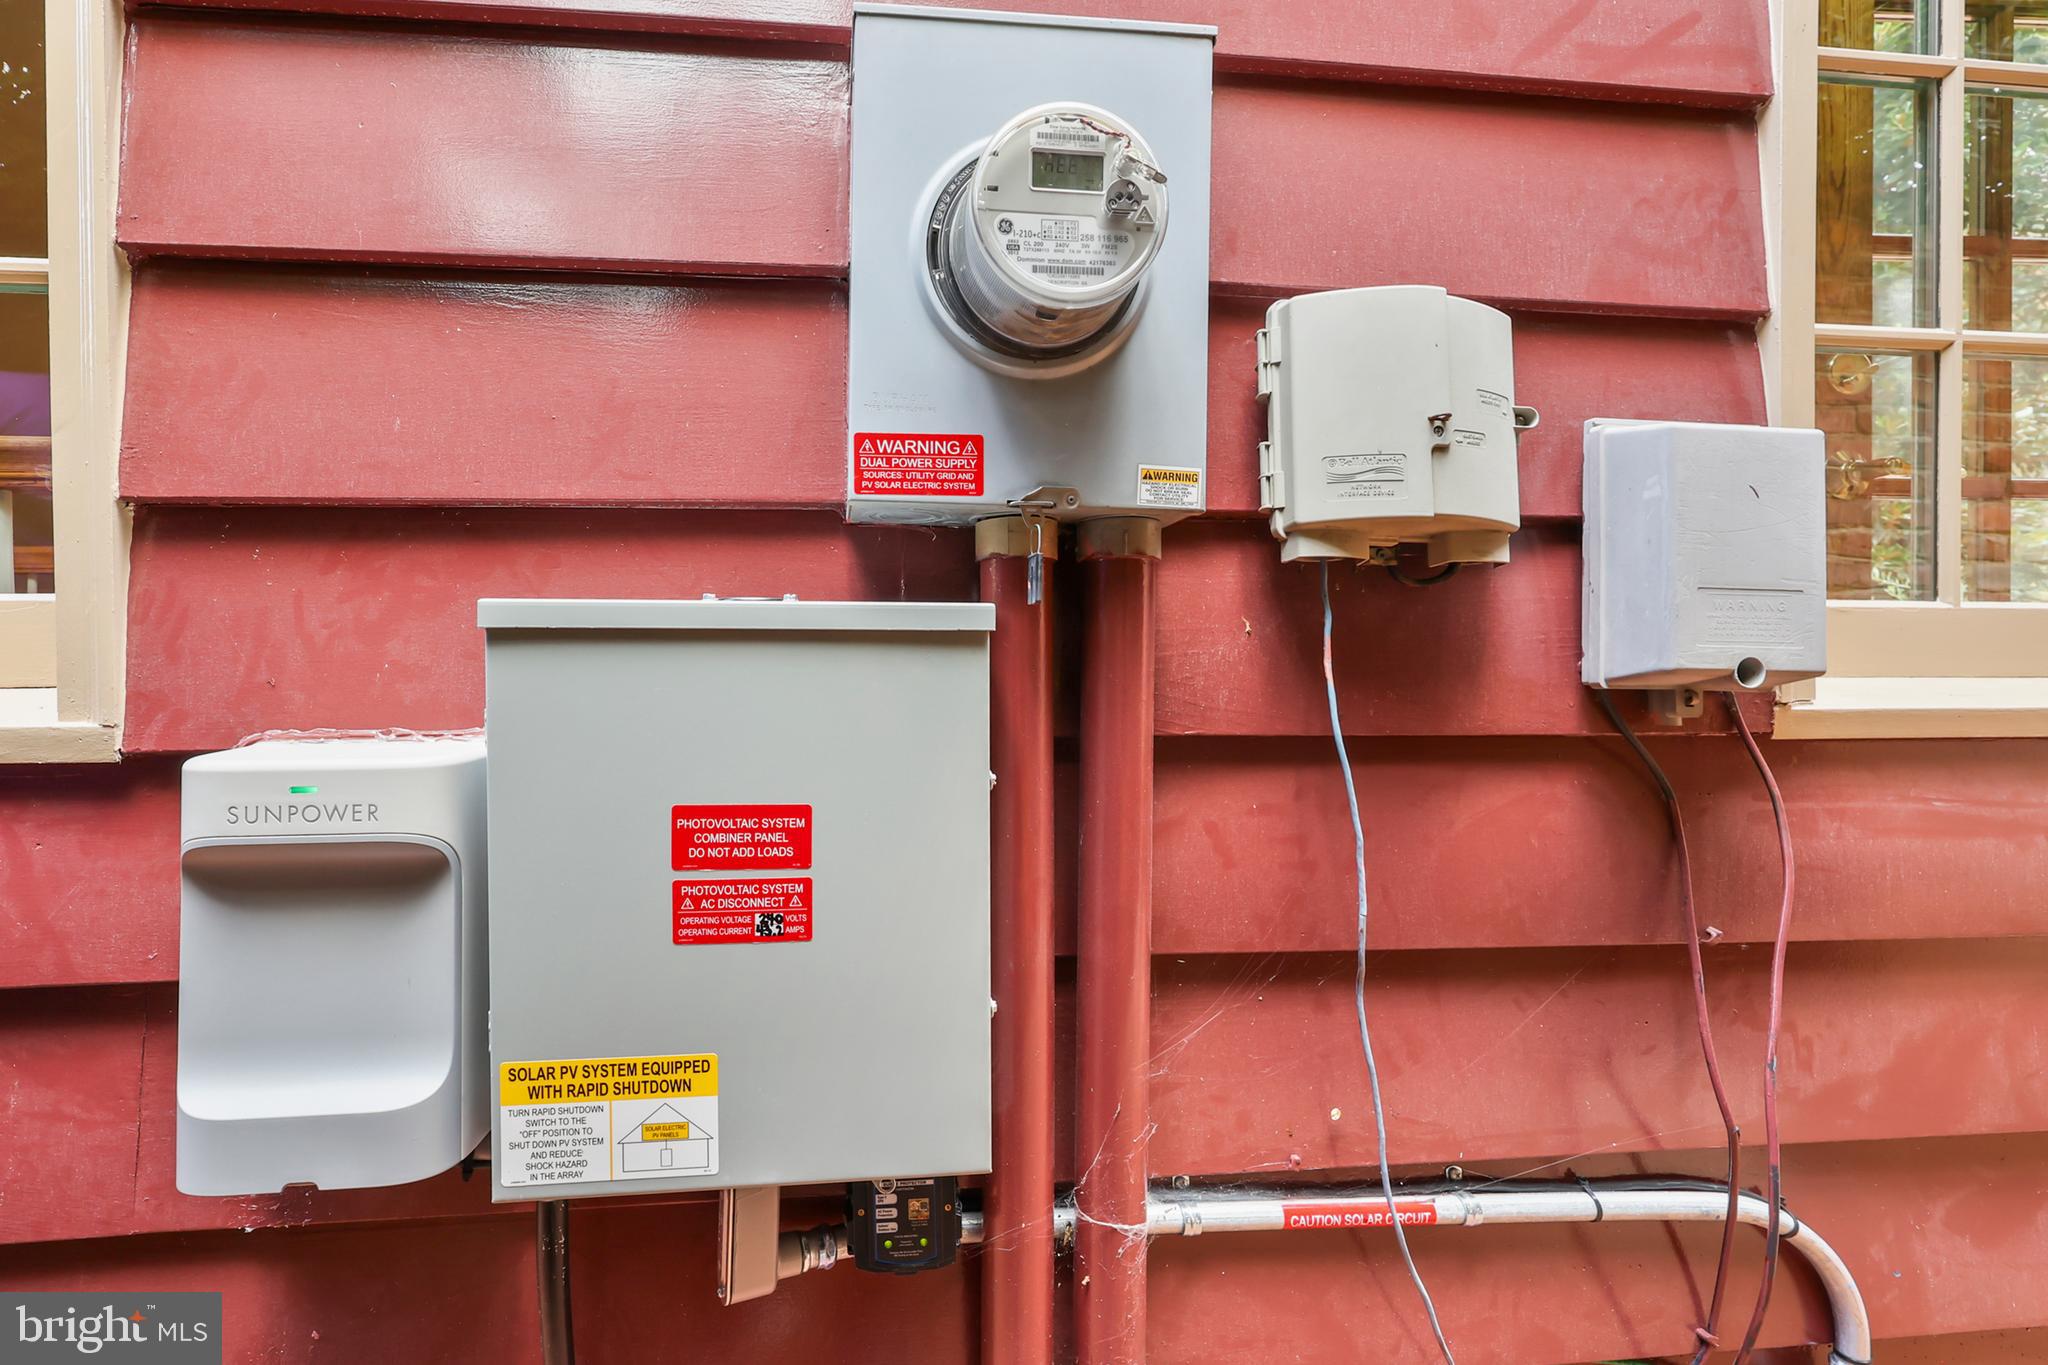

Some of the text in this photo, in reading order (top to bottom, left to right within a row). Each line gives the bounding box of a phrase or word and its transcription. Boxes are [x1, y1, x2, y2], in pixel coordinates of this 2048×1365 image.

[1017, 256, 1045, 264] Dominion
[876, 439, 960, 455] WARNING
[860, 457, 977, 469] DUAL POWER SUPPLY
[1338, 455, 1403, 466] Bell Atlantic
[863, 471, 974, 480] SOURCES: UTILITY GRID AND
[1153, 471, 1199, 483] WARNING
[862, 481, 976, 490] PV SOLAR ELECTRIC SYSTEM
[1713, 600, 1787, 612] WARNING
[227, 803, 379, 824] SUNPOWER
[677, 817, 805, 829] PHOTOVOLTAIC SYSTEM
[694, 832, 789, 843] COMBINER PANEL
[688, 847, 794, 858] DO NOT ADD LOADS
[681, 883, 804, 896] PHOTOVOLTAIC SYSTEM
[700, 897, 785, 909] AC DISCONNECT
[680, 916, 720, 925] OPERATING
[721, 915, 752, 924] VOLTAGE
[785, 914, 807, 922] VOLTS
[678, 927, 718, 936] OPERATING
[718, 926, 752, 936] CURRENT
[785, 925, 805, 934] AMPS
[508, 1059, 711, 1082] SOLAR PV SYSTEM EQUIPPED
[527, 1078, 692, 1100] WITH RAPID SHUTDOWN
[508, 1105, 604, 1118] TURN RAPID SHUTDOWN
[525, 1117, 587, 1127] SWITCH TO THE
[520, 1127, 593, 1139] "OFF" POSITION TO
[509, 1138, 604, 1150] SHUT DOWN PV SYSTEM
[530, 1150, 582, 1160] AND REDUCE
[525, 1160, 588, 1171] SHOCK HAZARD
[530, 1170, 584, 1181] IN THE ARRAY
[1290, 1212, 1431, 1228] CAUTION SOLAR CRCUIT
